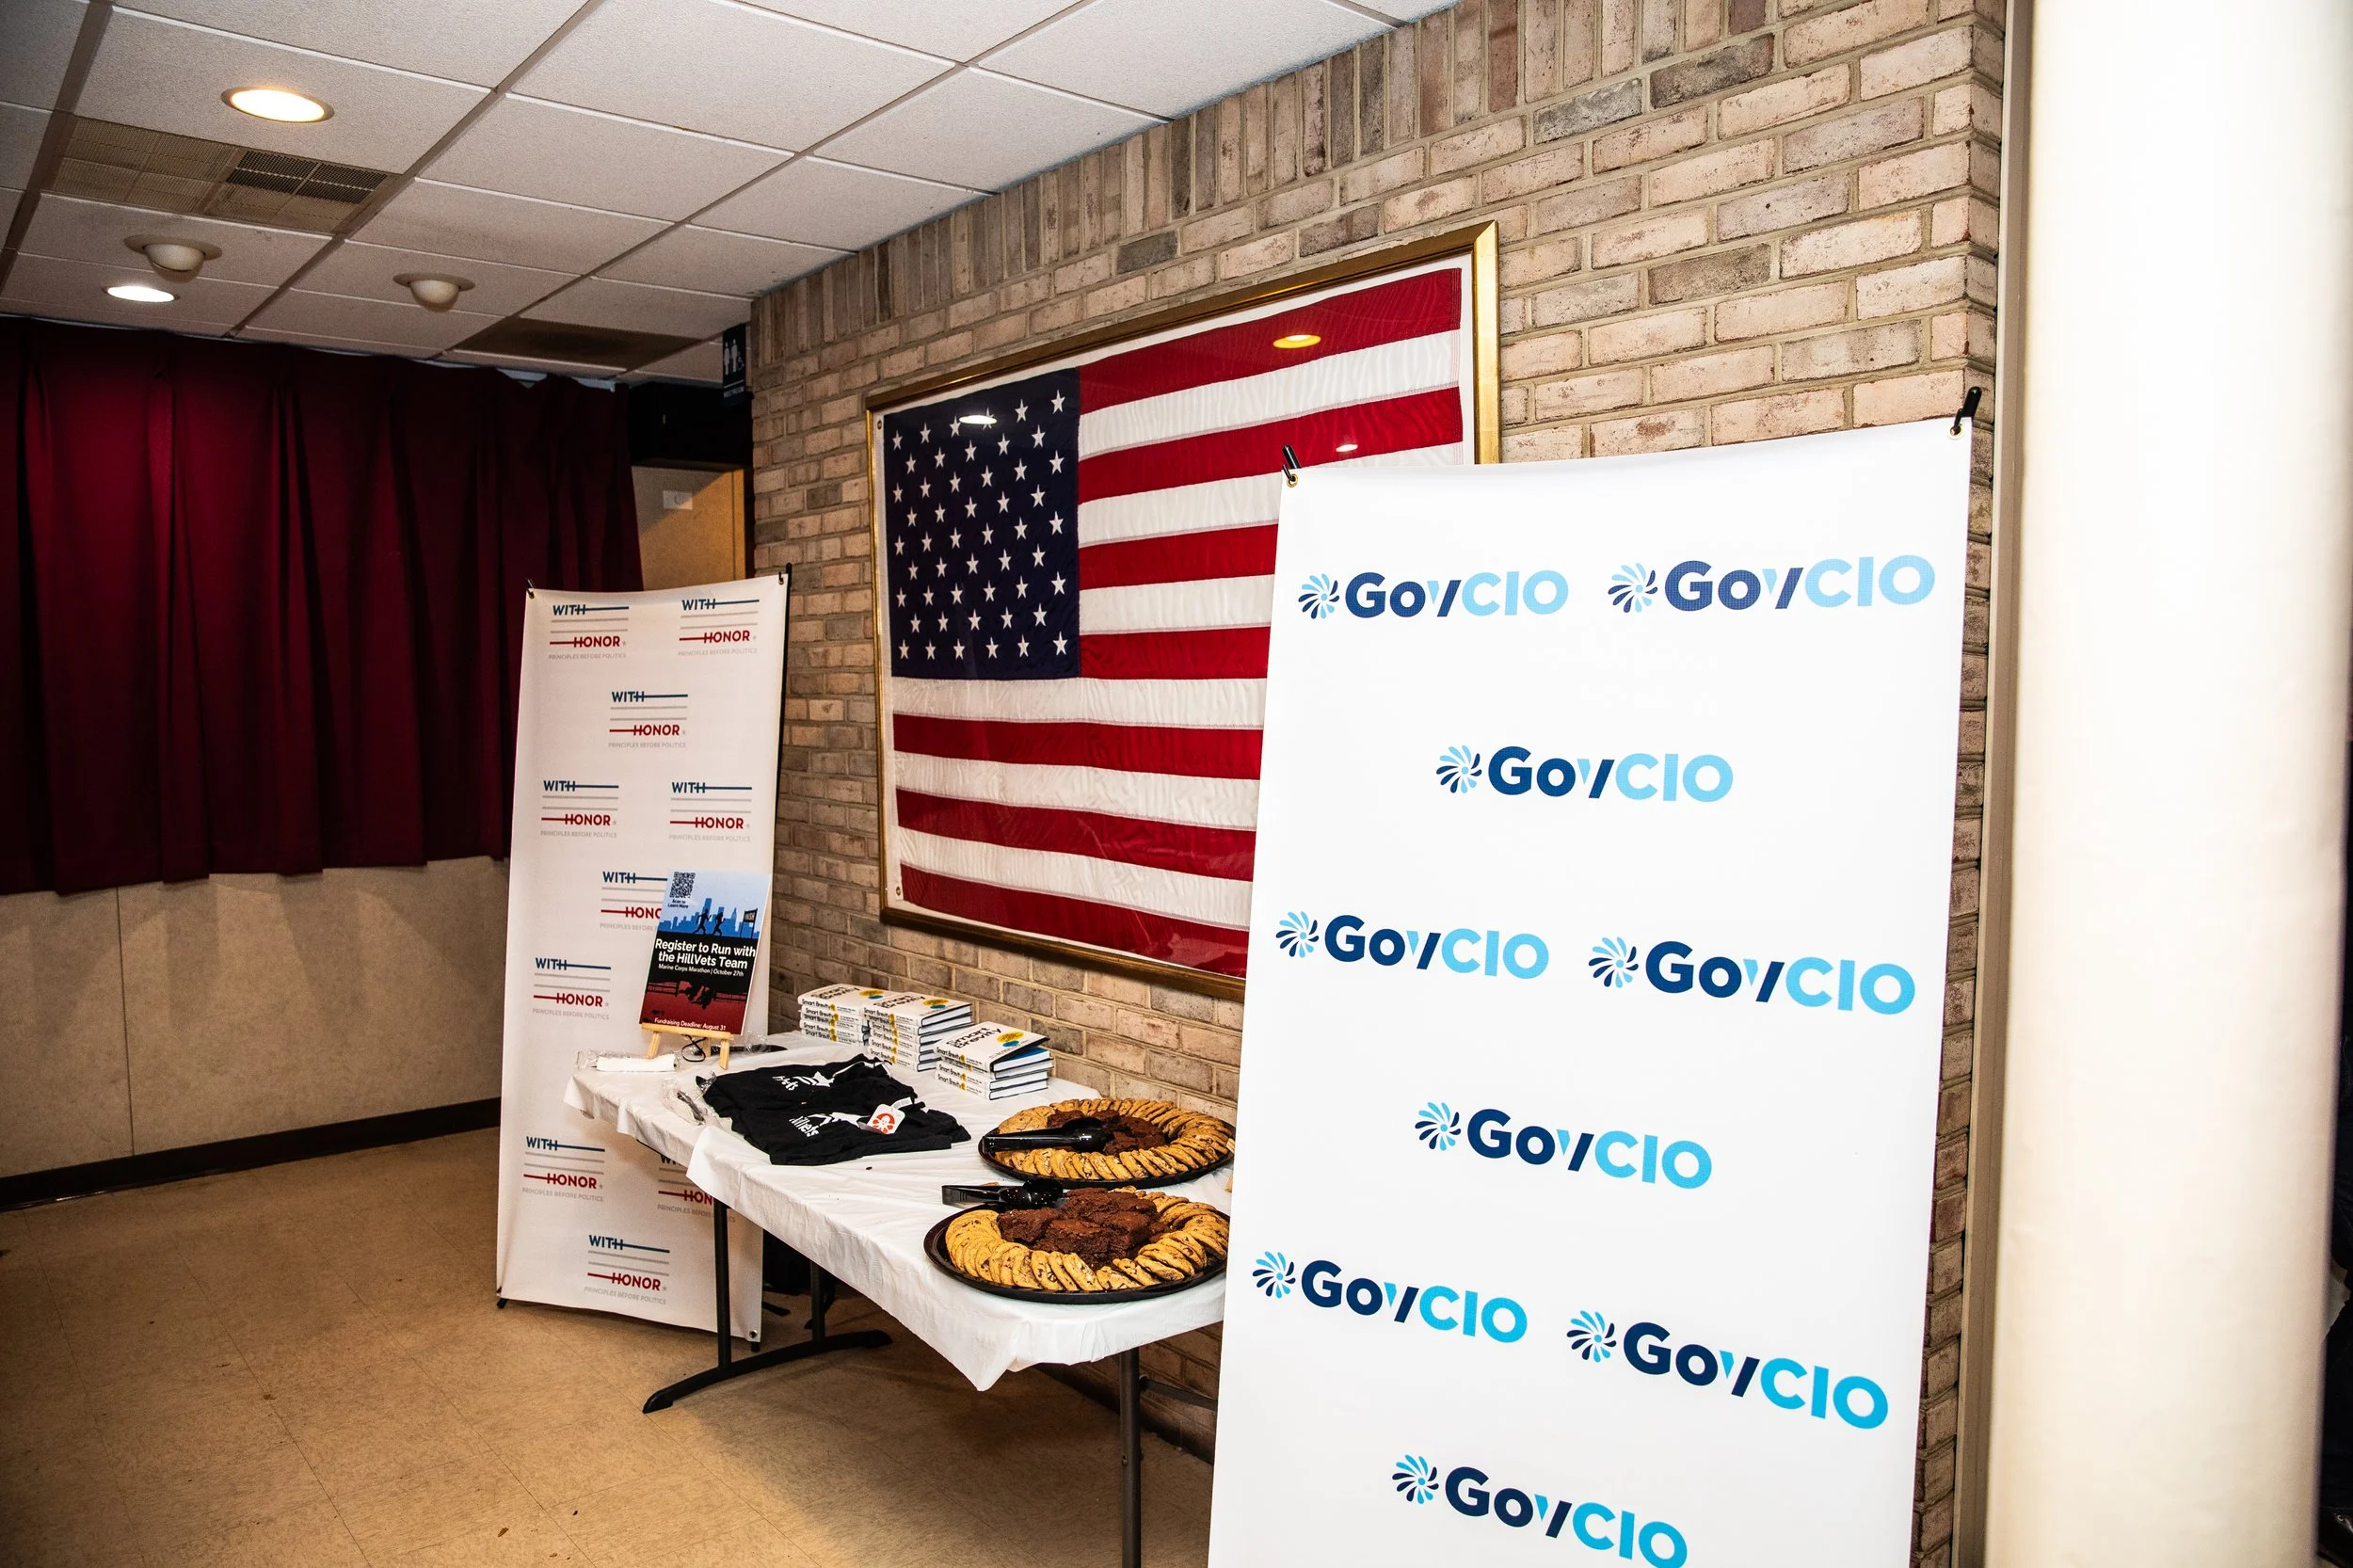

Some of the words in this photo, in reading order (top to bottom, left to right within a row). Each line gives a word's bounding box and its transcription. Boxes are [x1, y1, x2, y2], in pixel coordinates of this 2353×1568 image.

[1664, 556, 1935, 612] GovCIO
[1345, 570, 1569, 618] GovCIO
[552, 604, 585, 616] WITH
[682, 599, 715, 611] WITH
[574, 636, 620, 648] HONOR
[704, 631, 749, 643] HONOR
[612, 691, 645, 702] WITH
[633, 725, 680, 736] HONOR
[1487, 746, 1734, 803] GovCIO
[543, 780, 576, 792] WITH
[671, 782, 706, 793] WITH
[565, 814, 611, 826] HONOR
[695, 817, 744, 829] HONOR
[602, 872, 636, 884] WITH
[625, 906, 662, 920] HONO
[655, 938, 697, 952] Register
[698, 942, 710, 953] to
[711, 943, 731, 955] Run
[733, 945, 756, 957] with
[1324, 914, 1550, 980] GovCIO
[535, 957, 567, 970] WITH
[658, 951, 675, 962] the
[677, 952, 716, 967] HillVets
[718, 956, 748, 969] Team
[1645, 940, 1916, 1016] GovCIO
[556, 993, 602, 1007] HONOR
[654, 1017, 680, 1026] Fundraising
[953, 1028, 1002, 1048] Brevity
[526, 1136, 558, 1151] WITH
[1466, 1109, 1713, 1190] GovCIO
[547, 1173, 597, 1190] HONOR
[683, 1190, 712, 1205] HON
[589, 1235, 623, 1250] WITH
[612, 1272, 661, 1291] HONOR
[1301, 1259, 1529, 1344] GovCIO
[1623, 1321, 1890, 1431] GovCIO
[1445, 1466, 1689, 1568] GovCIO
